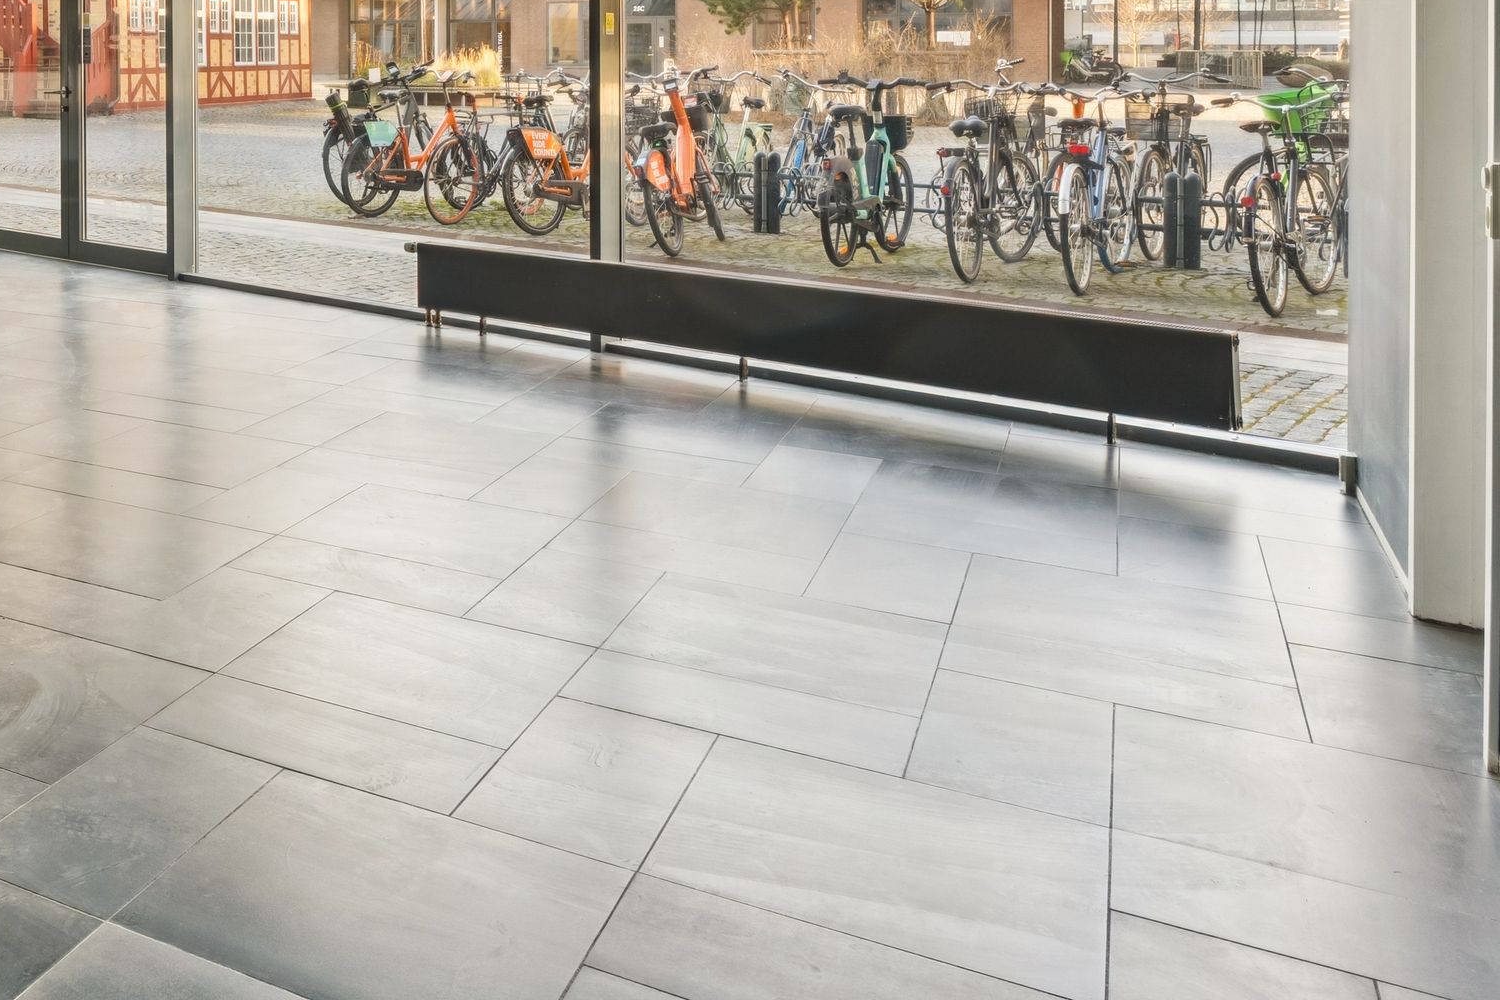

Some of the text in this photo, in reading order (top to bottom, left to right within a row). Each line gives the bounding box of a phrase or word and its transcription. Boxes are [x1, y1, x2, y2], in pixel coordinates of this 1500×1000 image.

[531, 132, 549, 140] EVERY
[532, 140, 546, 148] RIDE
[533, 148, 557, 157] COUNTS
